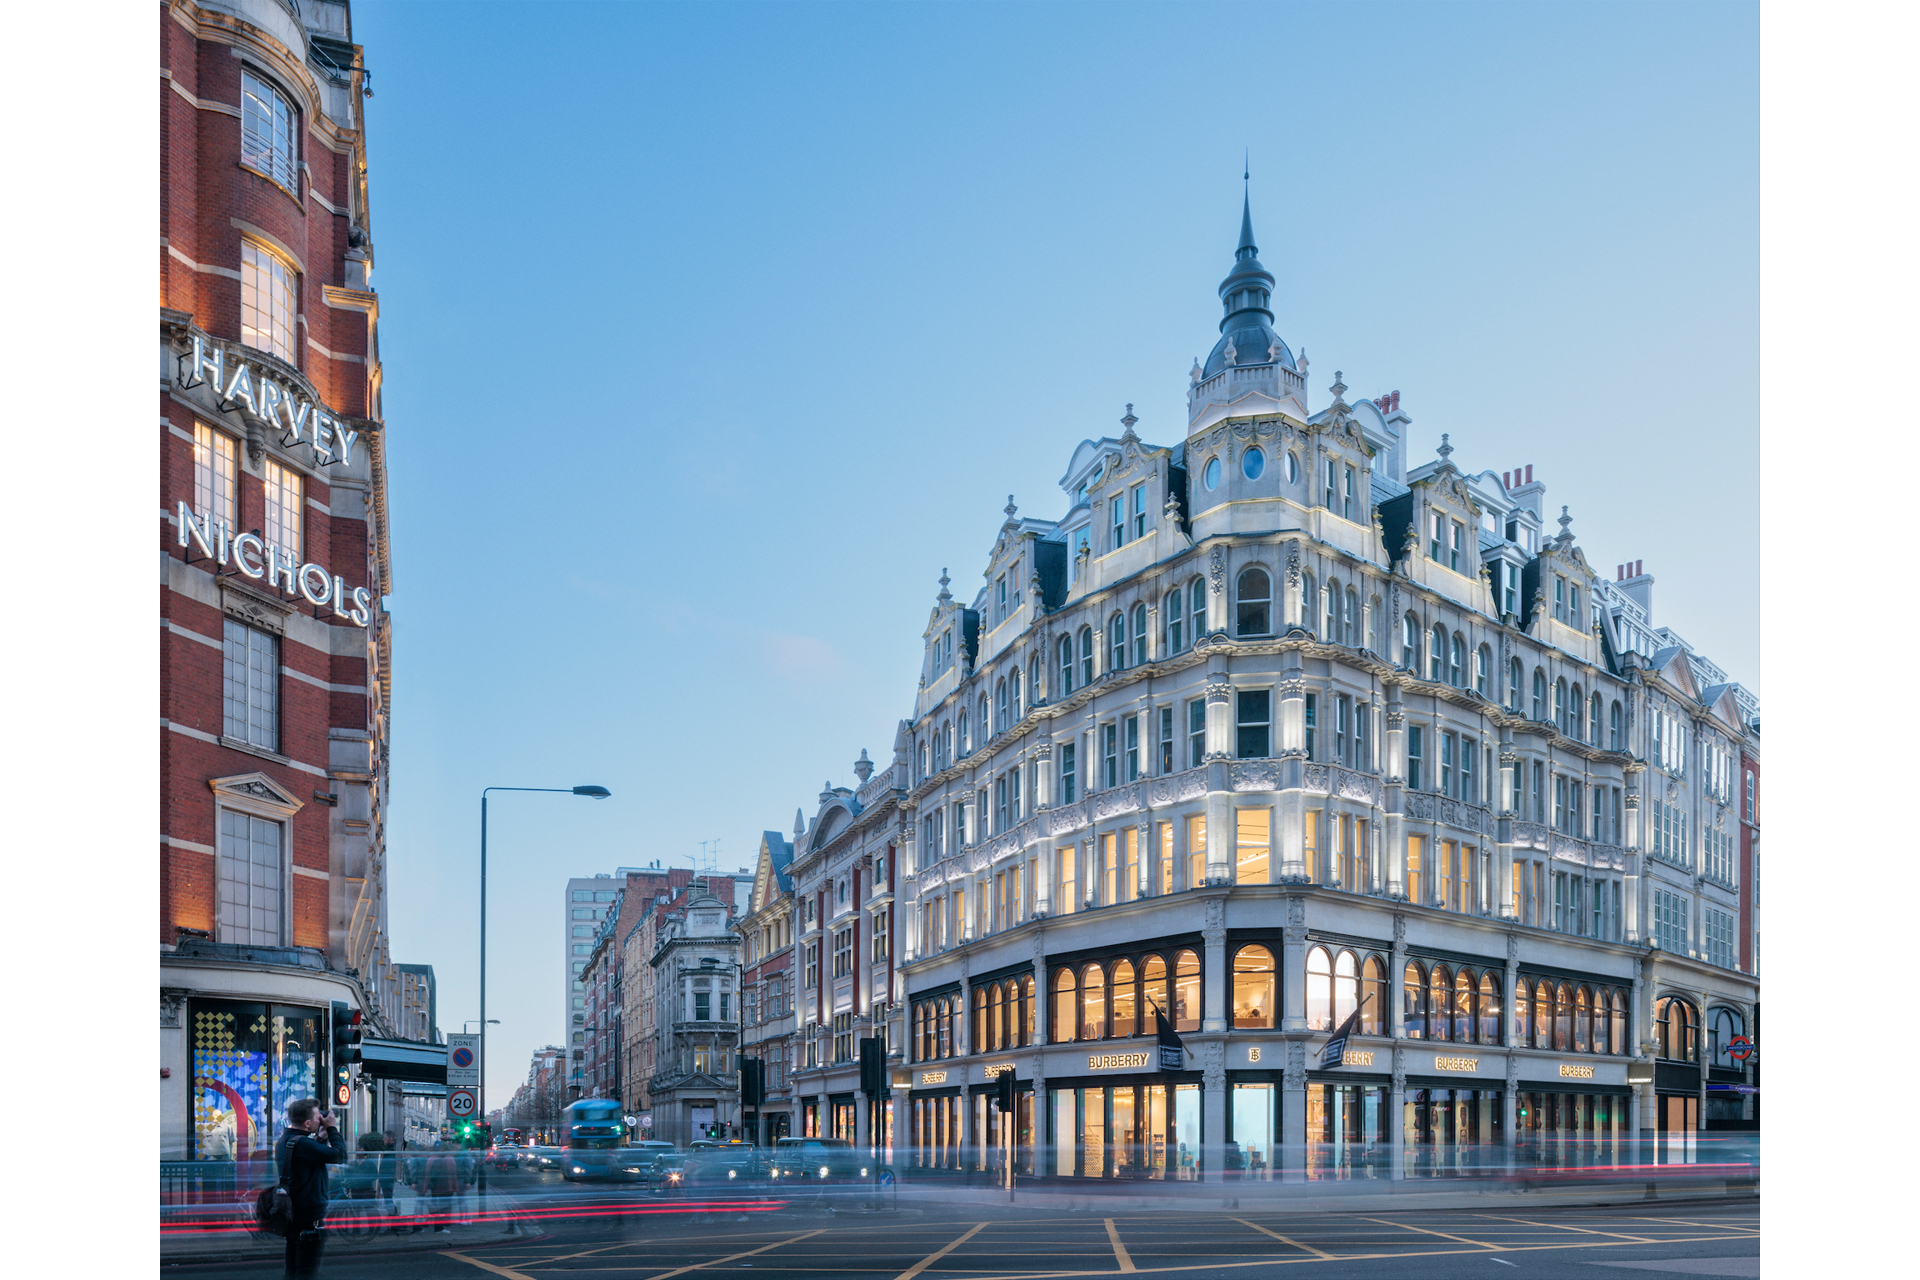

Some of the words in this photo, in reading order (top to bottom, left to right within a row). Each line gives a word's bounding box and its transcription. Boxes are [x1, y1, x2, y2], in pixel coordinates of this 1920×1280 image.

[193, 336, 358, 466] HARVEY
[177, 500, 371, 627] NICHOLS
[1088, 1052, 1149, 1069] BURBERRY
[1341, 1051, 1375, 1065] BERRY
[1435, 1056, 1478, 1072] BURBERRY
[922, 1071, 947, 1084] BURBERRY
[1559, 1064, 1595, 1079] BURBERRY
[453, 1098, 472, 1109] 20
